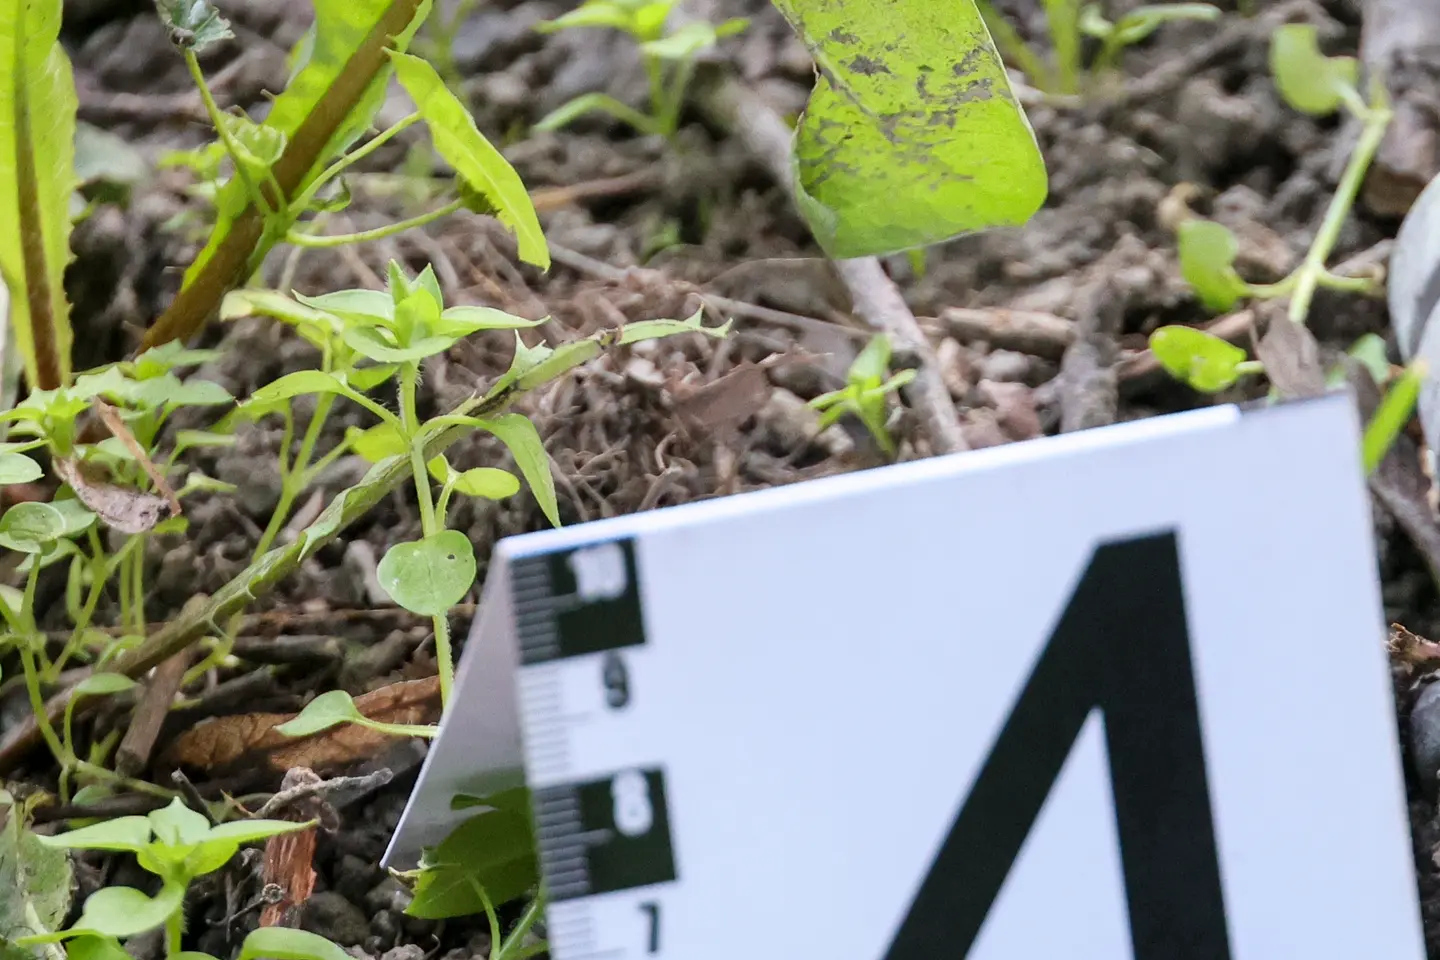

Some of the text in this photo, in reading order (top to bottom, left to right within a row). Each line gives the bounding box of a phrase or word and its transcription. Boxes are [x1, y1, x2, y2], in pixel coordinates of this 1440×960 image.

[604, 651, 630, 709] 9
[611, 768, 653, 836] 8
[638, 900, 662, 955] 7
